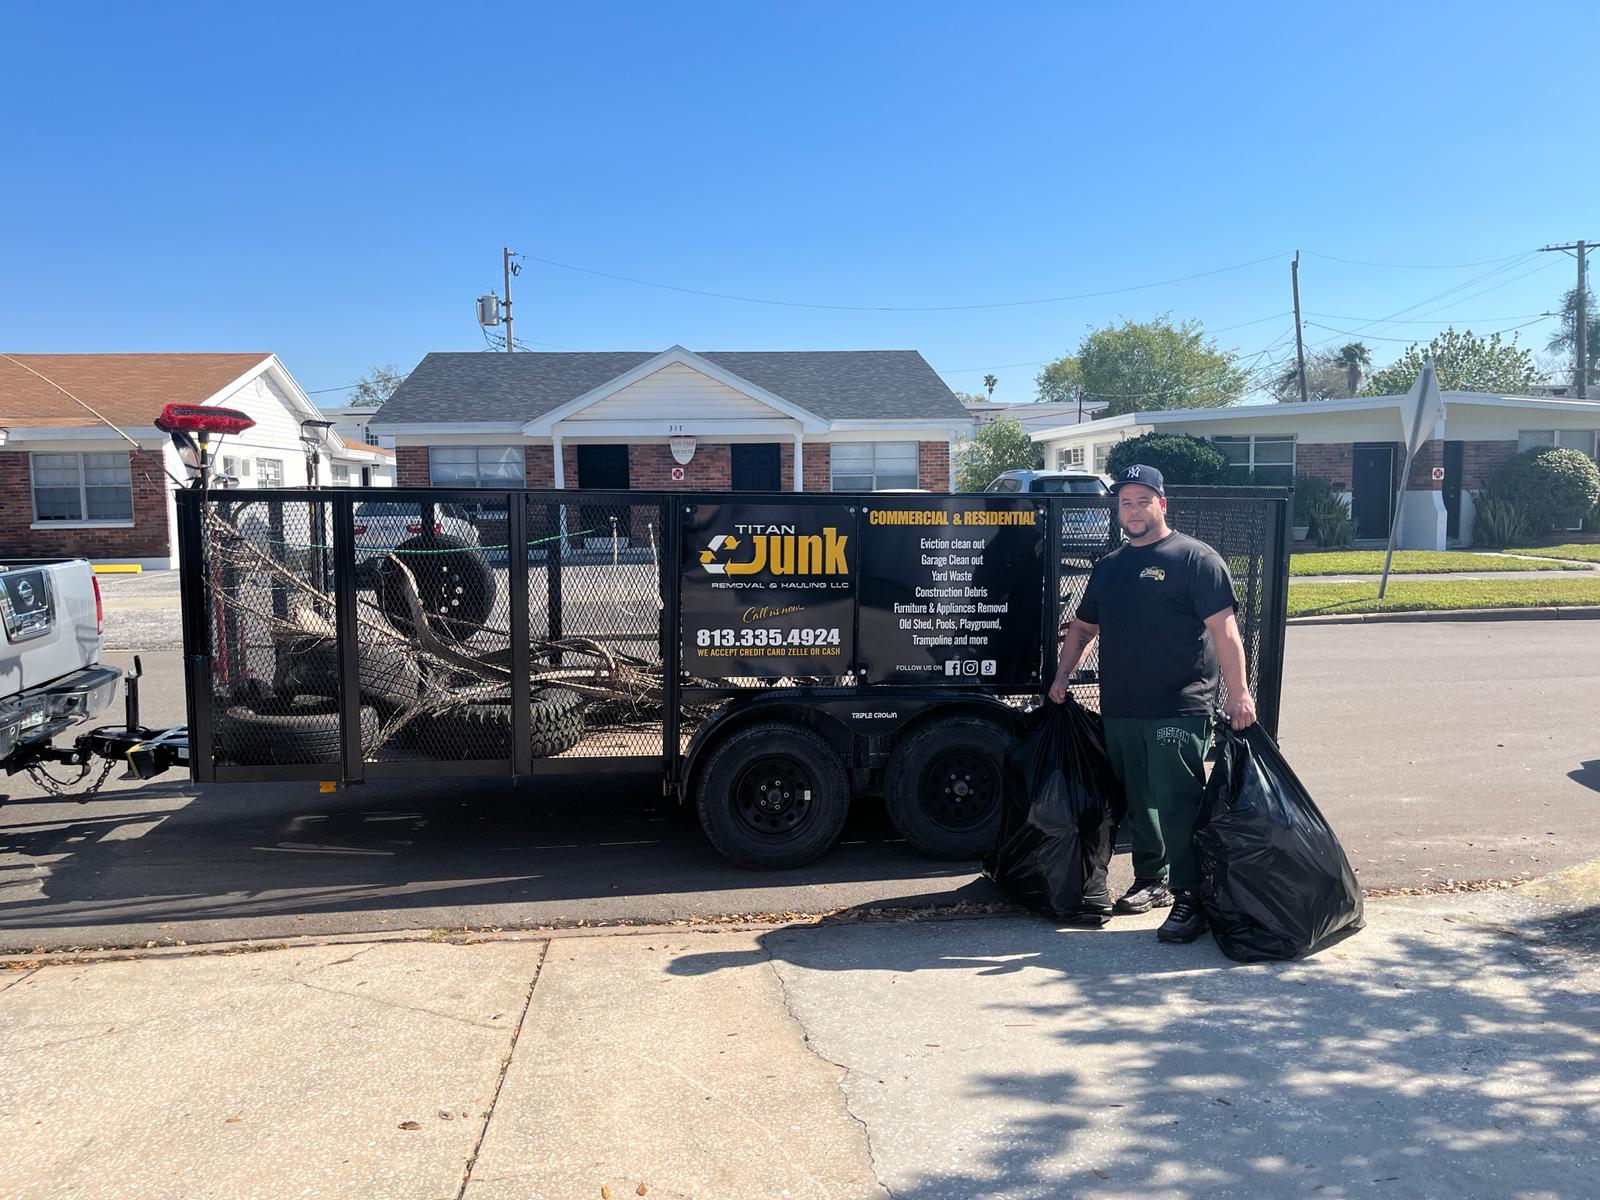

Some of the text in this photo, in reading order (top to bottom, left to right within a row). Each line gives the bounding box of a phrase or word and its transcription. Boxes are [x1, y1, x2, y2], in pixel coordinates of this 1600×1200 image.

[1127, 468, 1140, 478] NY
[869, 510, 1036, 525] COMMERCIAL & RESIDENTIAL
[735, 525, 795, 534] TITAN
[920, 538, 985, 549] Eviction clean out
[724, 528, 848, 576] Junk
[922, 554, 983, 567] Garage Clean out
[932, 571, 972, 581] Yard Waste
[916, 587, 988, 598] Construction Debris
[742, 606, 768, 624] Call
[770, 608, 780, 617] us
[894, 603, 1008, 615] Furniture & Appliances Removal
[900, 619, 1001, 631] Old Shed, Pools, Playground,
[697, 628, 840, 646] 813.335.4924
[913, 635, 988, 647] Trampoline and more
